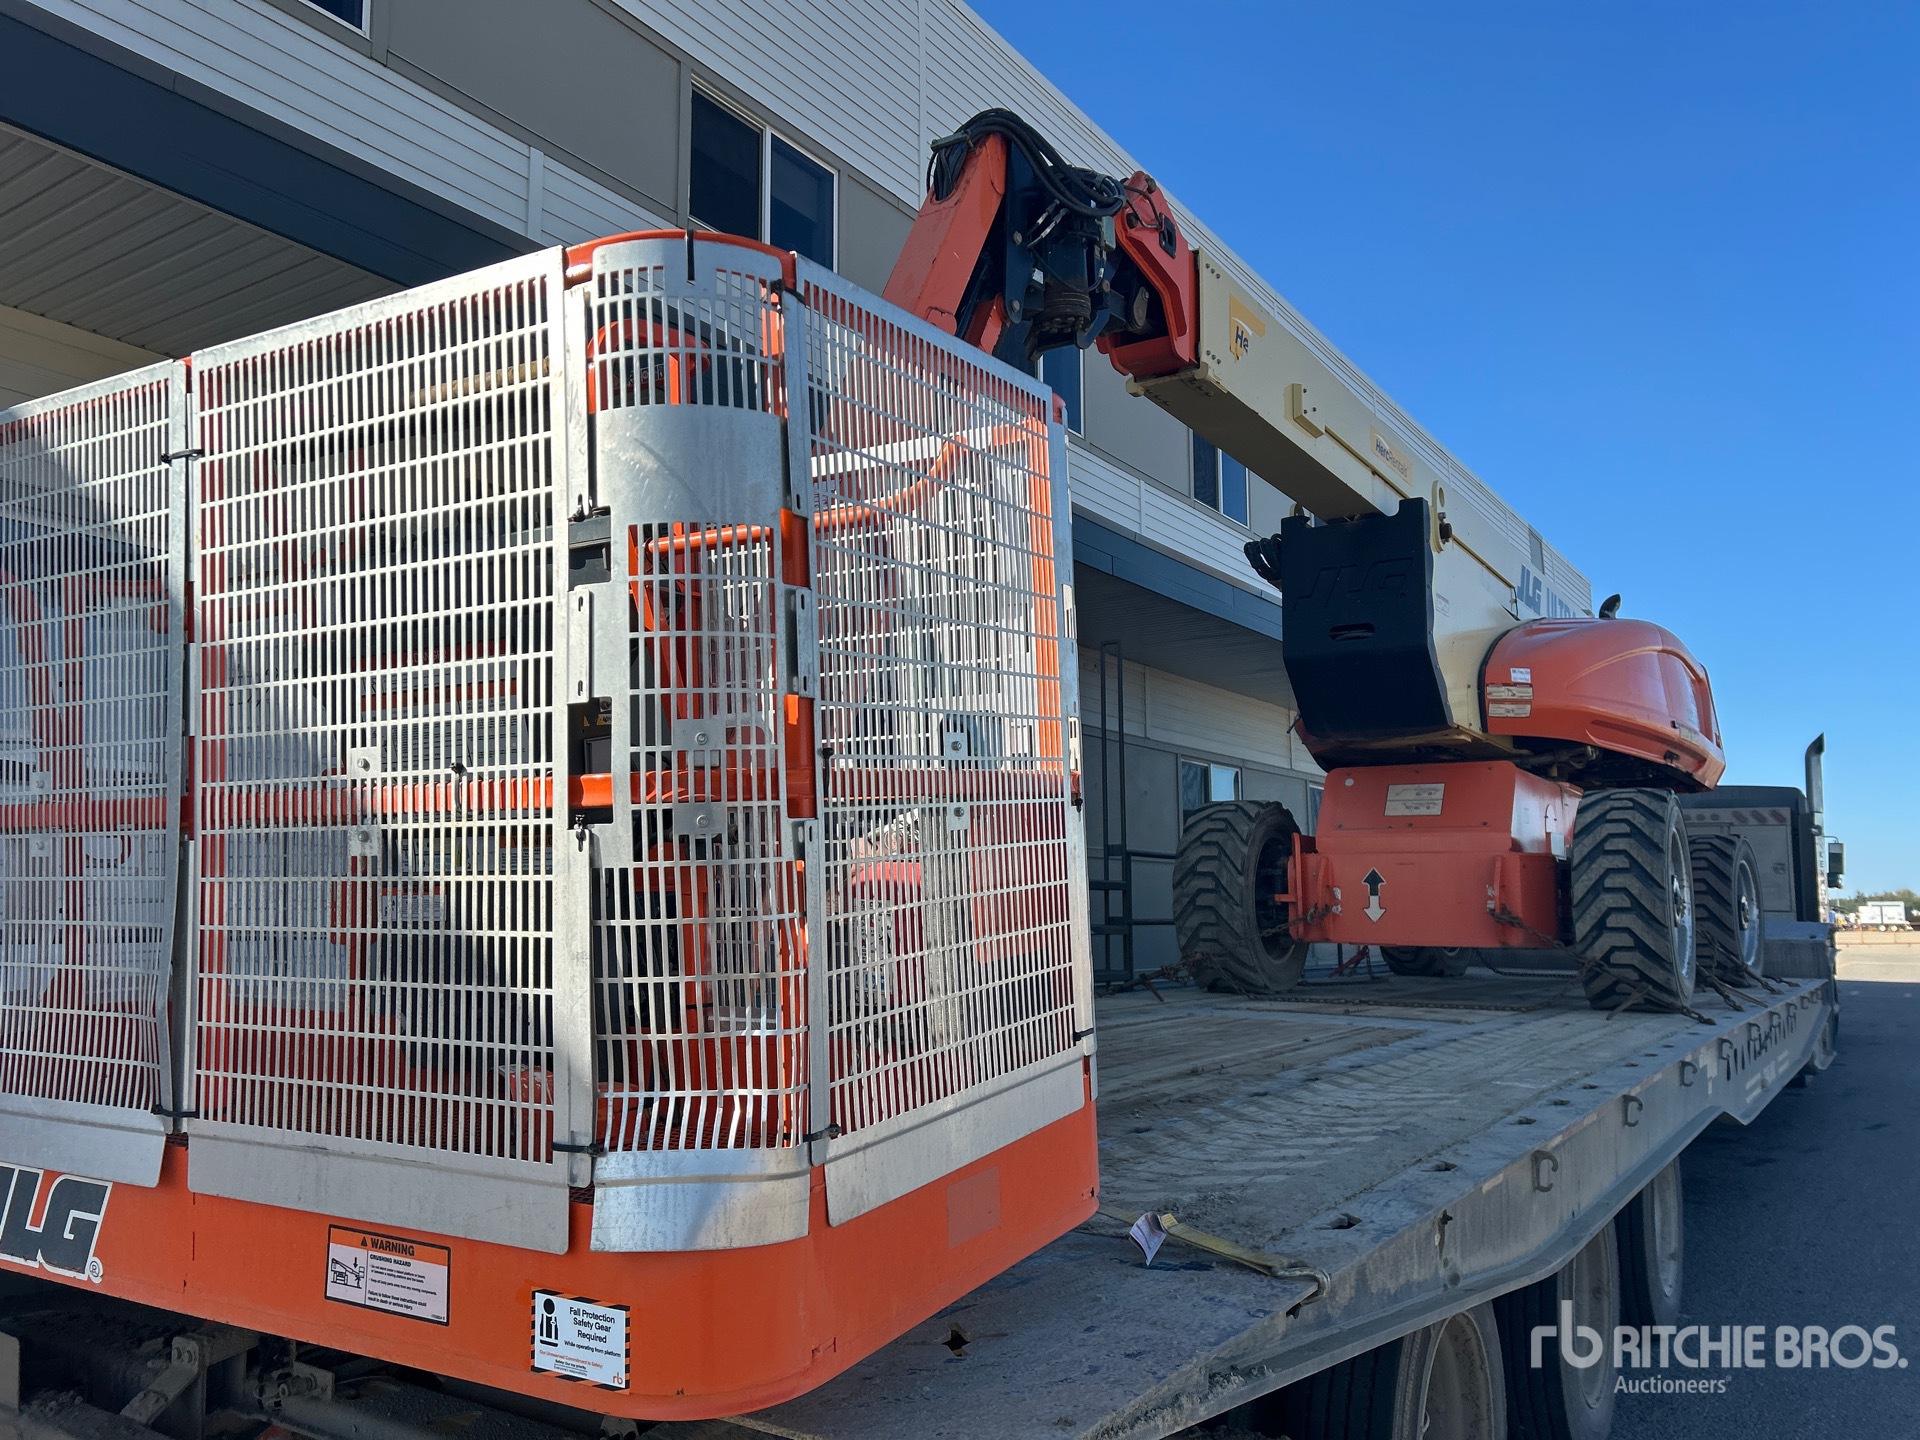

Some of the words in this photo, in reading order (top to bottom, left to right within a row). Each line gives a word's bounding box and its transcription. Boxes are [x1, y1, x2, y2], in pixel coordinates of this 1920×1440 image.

[1516, 564, 1542, 616] JLG
[371, 1238, 414, 1256] WARNING
[370, 1254, 392, 1263] CRUSHING
[393, 1258, 411, 1267] HAZARD
[569, 1306, 580, 1316] Fall
[581, 1309, 616, 1324] Protection
[573, 1317, 595, 1331] Safety
[594, 1322, 612, 1333] Gear
[577, 1329, 607, 1344] Required
[563, 1340, 576, 1348] While
[575, 1342, 595, 1353] operating
[604, 1349, 622, 1358] platform
